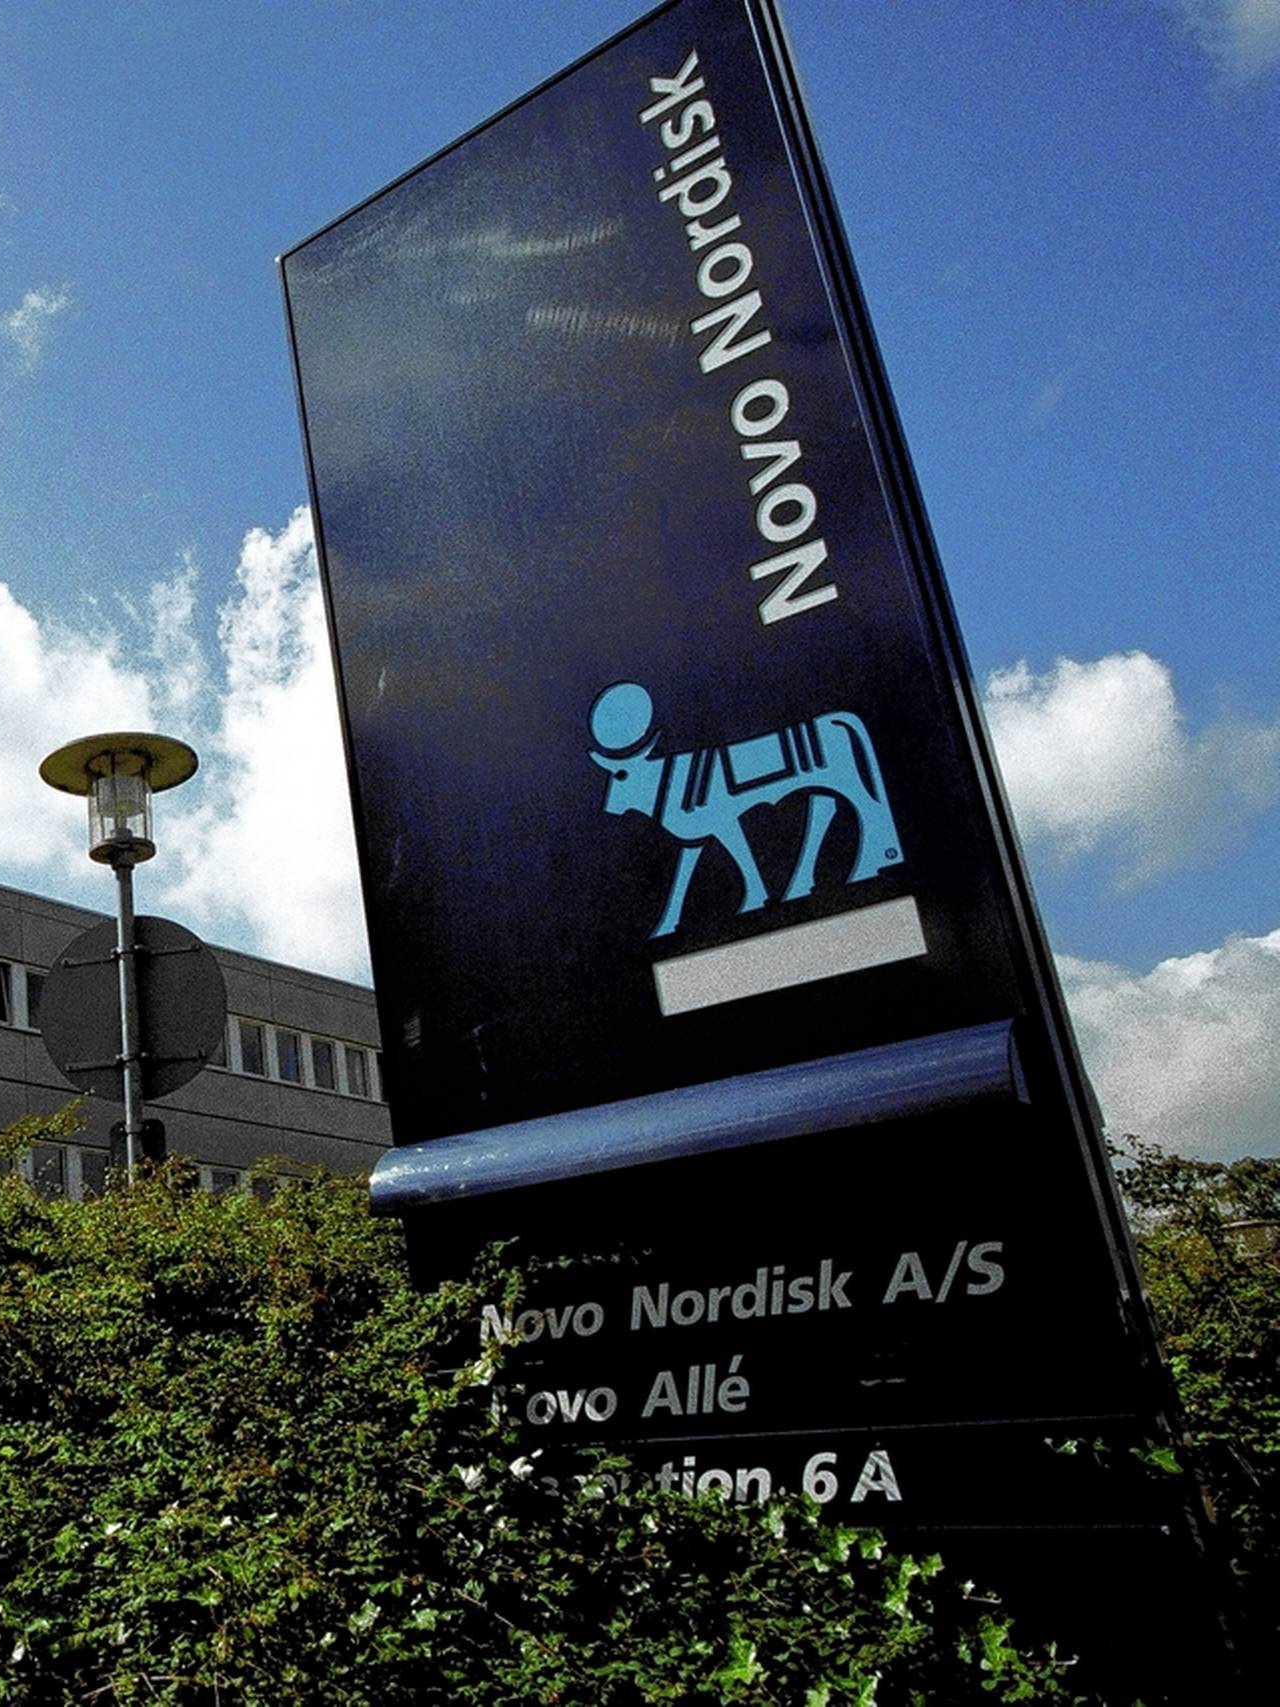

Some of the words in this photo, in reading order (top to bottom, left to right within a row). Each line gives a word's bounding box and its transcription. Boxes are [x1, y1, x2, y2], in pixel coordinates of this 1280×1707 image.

[639, 48, 772, 374] Nordisk
[730, 379, 838, 625] Novo
[479, 1302, 605, 1347] Novo
[630, 1258, 853, 1331] Nordisk
[882, 1240, 1005, 1304] A/S
[490, 1386, 618, 1425] ovo
[640, 1354, 751, 1418] Allé
